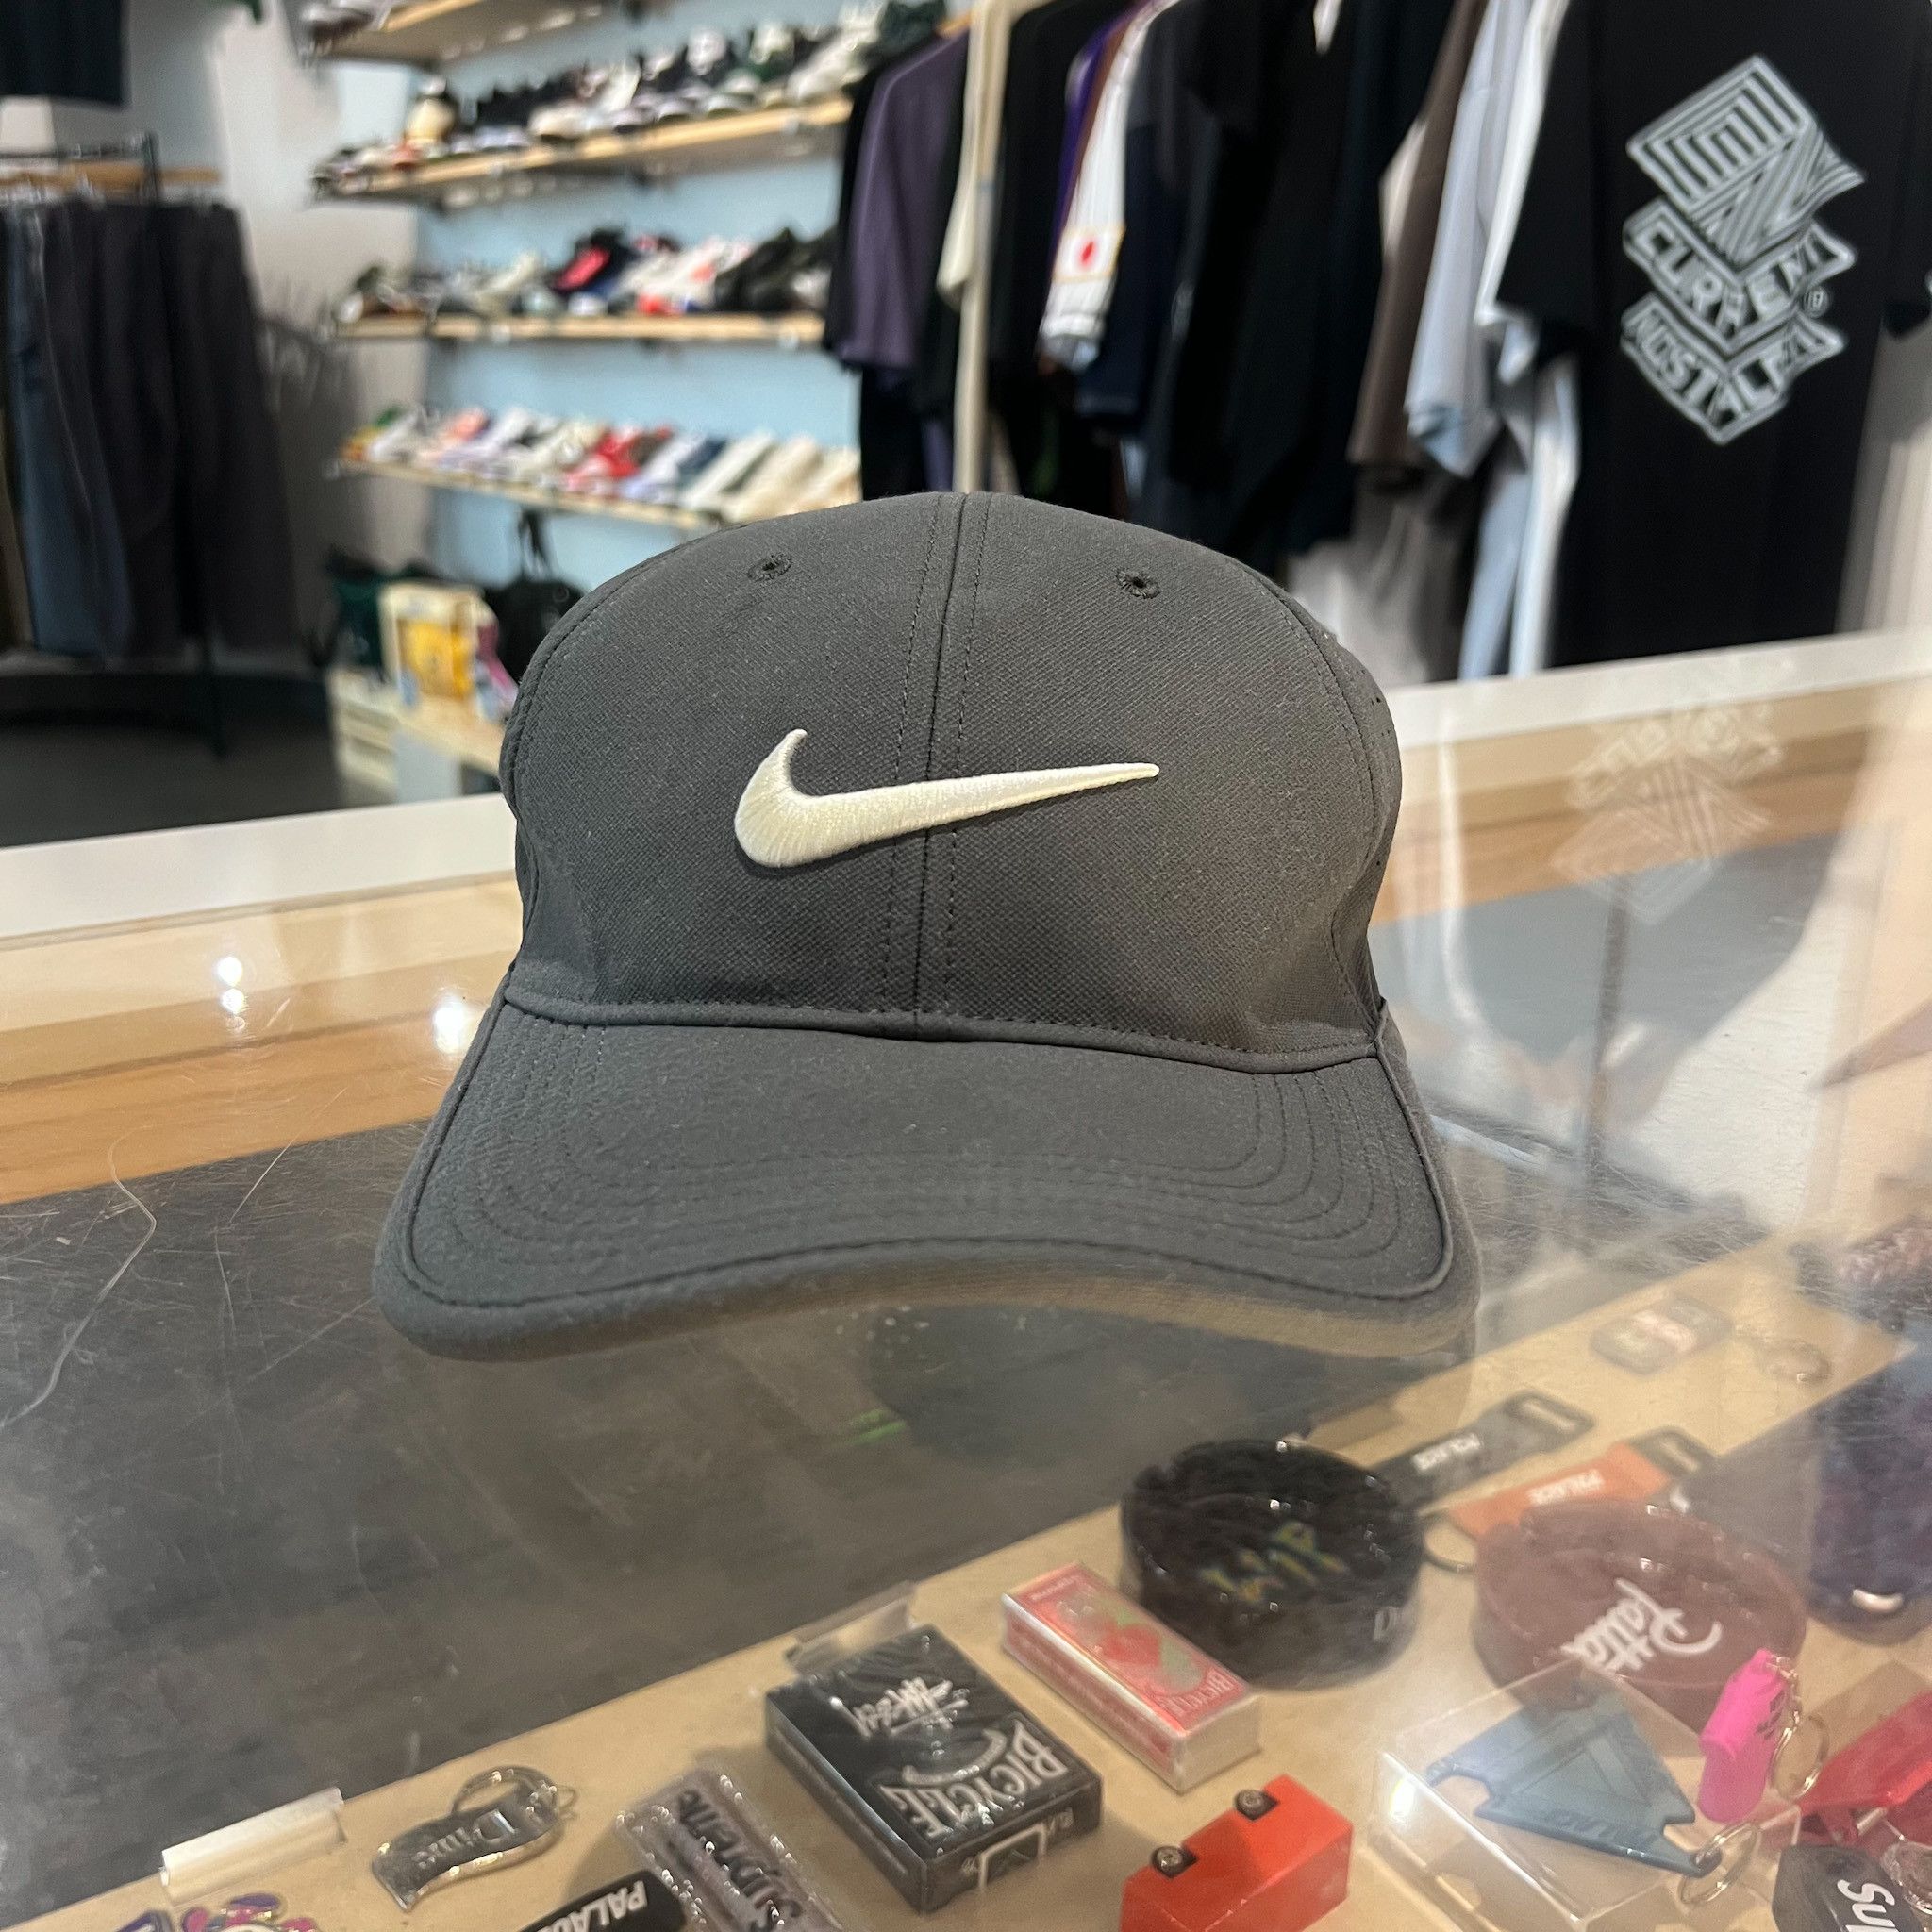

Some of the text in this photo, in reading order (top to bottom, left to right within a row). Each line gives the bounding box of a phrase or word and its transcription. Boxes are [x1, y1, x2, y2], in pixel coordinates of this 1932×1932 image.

[1561, 1577, 1722, 1673] Patta
[878, 1717, 1069, 1839] BICYCLE
[1837, 1879, 1900, 1932] Su
